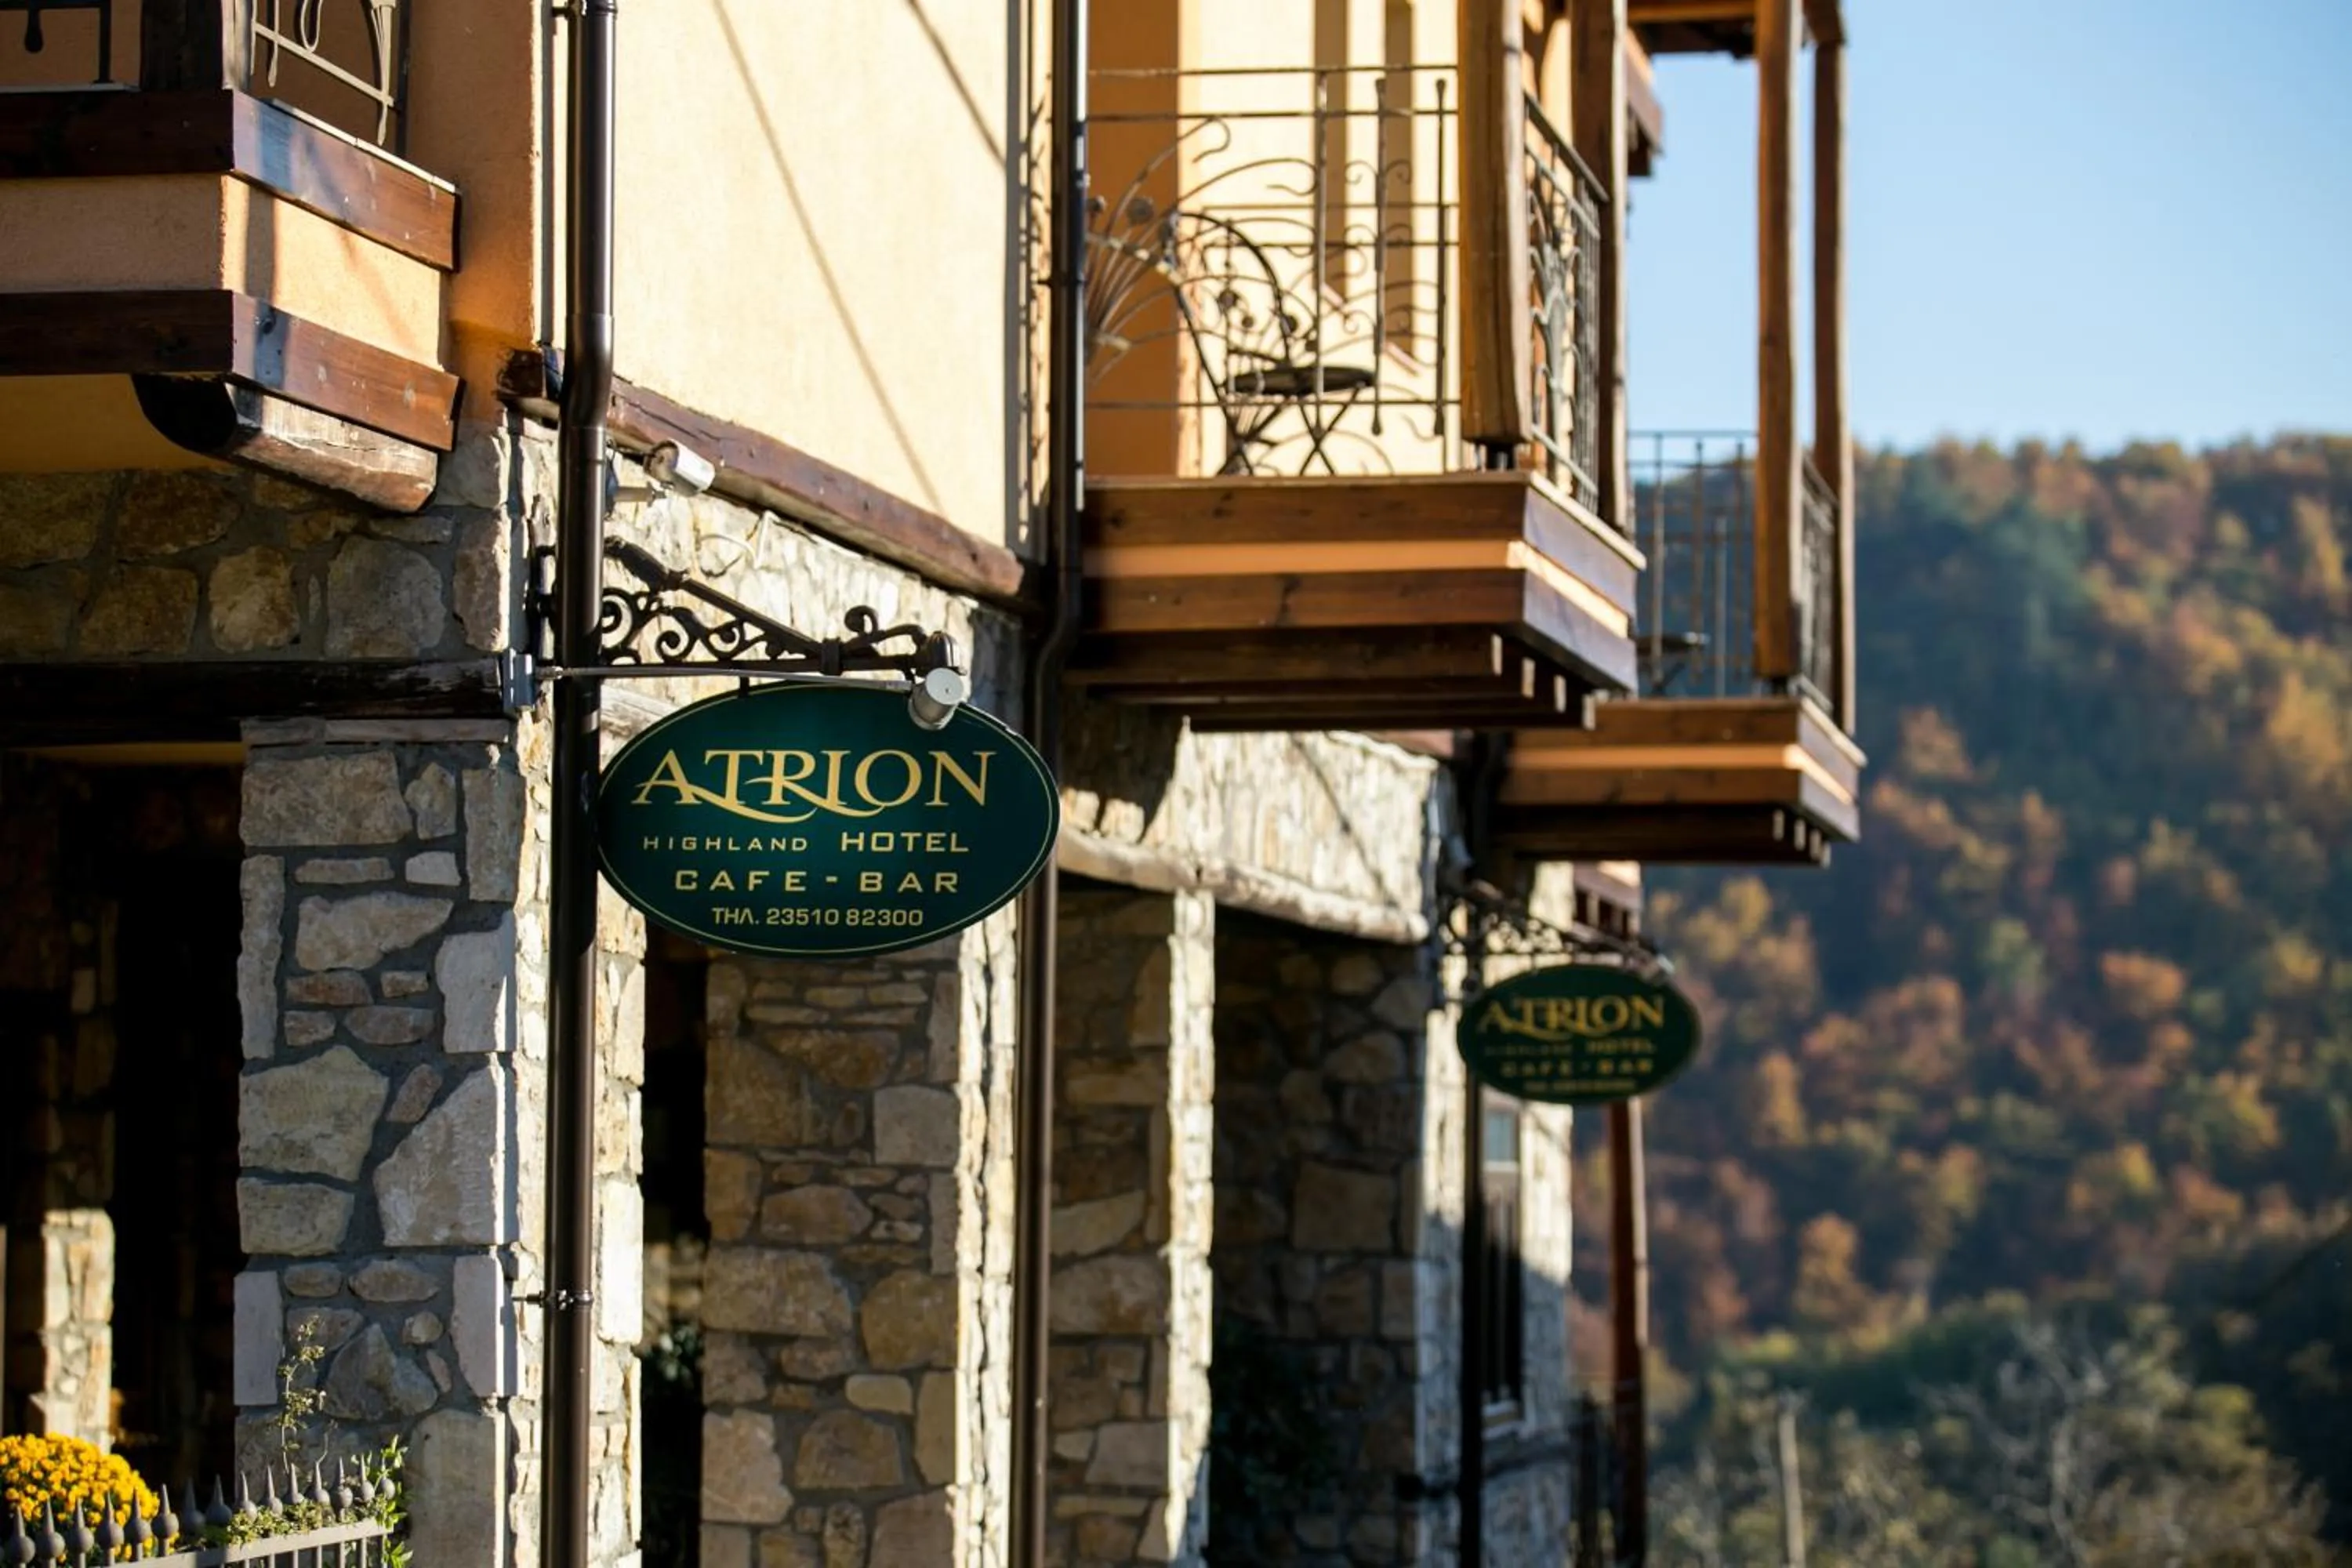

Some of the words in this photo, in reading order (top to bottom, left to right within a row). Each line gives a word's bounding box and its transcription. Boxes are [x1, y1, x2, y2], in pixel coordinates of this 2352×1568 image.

[631, 749, 996, 823] ATRION
[643, 835, 808, 851] HIGHLAND
[840, 831, 969, 852] HOTEL
[766, 908, 840, 926] 23510
[845, 909, 924, 927] 82300
[1478, 995, 1664, 1041] ATRION
